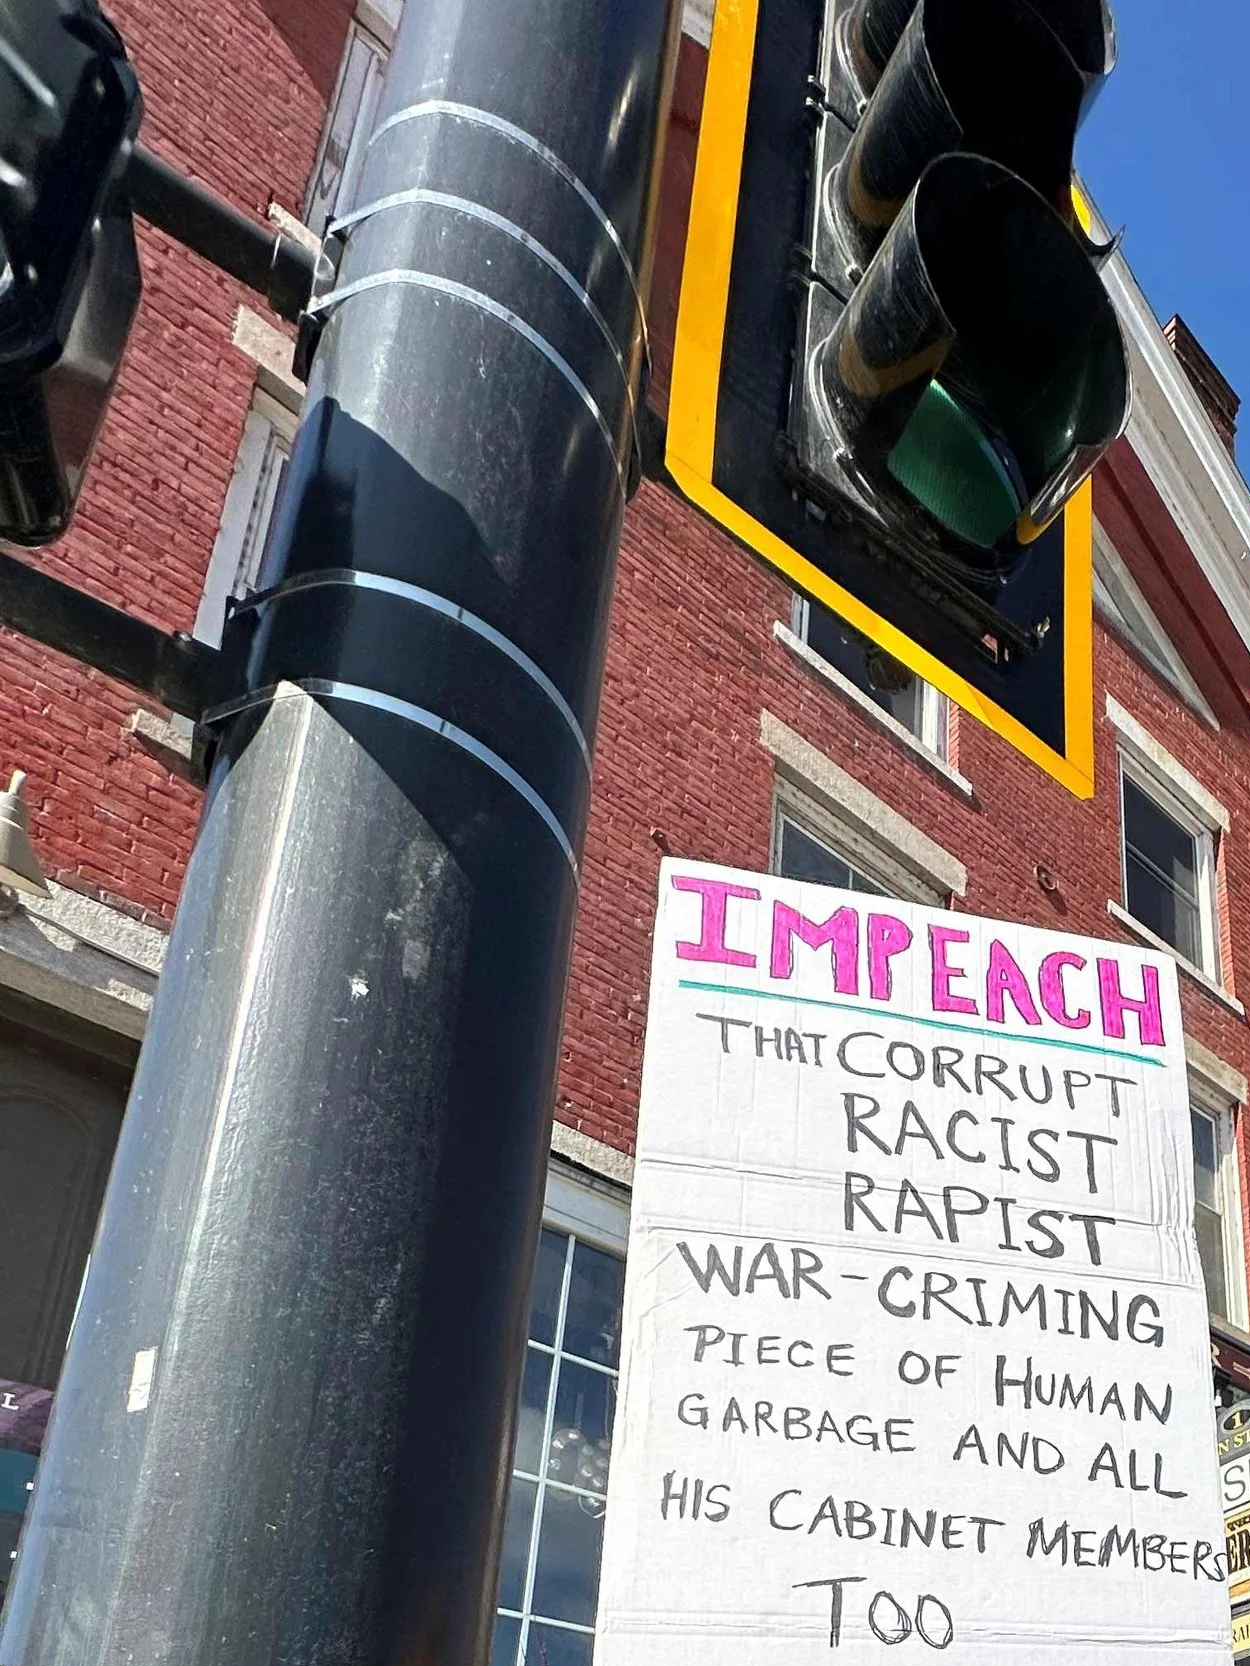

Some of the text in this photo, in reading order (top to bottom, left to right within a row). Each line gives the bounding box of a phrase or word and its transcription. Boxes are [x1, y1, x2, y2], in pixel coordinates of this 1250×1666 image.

[671, 875, 1166, 1046] IMPEACH
[696, 1012, 1137, 1117] THAT CORRUPT
[840, 1092, 1118, 1193] RACIST
[844, 1172, 1115, 1266] RAPIST
[684, 1325, 855, 1377] PIECE
[898, 1351, 962, 1389] OF
[995, 1355, 1172, 1424] HUMAN
[1231, 1411, 1243, 1430] 1
[678, 1394, 1187, 1499] GARBAGE AND ALL
[660, 1470, 1226, 1583] HIS CABINET MEMBERS
[792, 1576, 954, 1649] TOO
